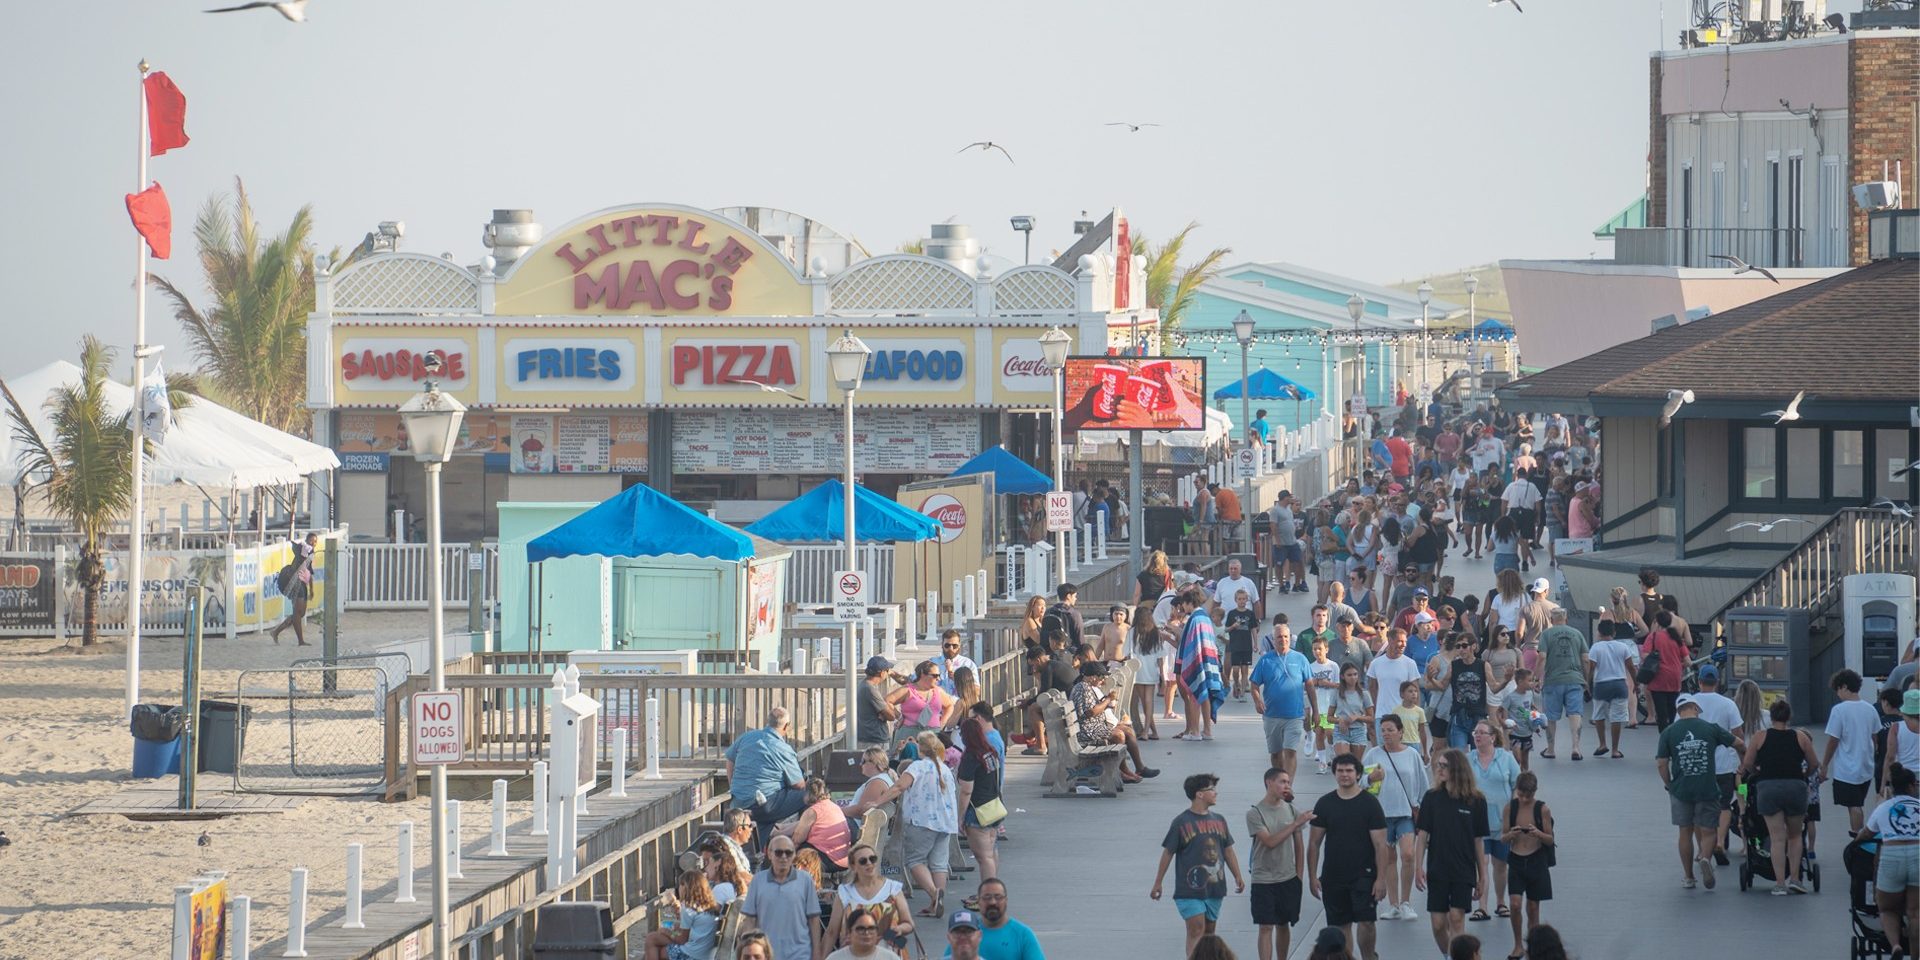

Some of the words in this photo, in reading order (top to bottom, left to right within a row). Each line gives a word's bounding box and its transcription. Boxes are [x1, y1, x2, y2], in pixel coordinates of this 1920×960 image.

[555, 214, 754, 274] LITTLE
[518, 348, 621, 382] FRIES
[673, 345, 797, 385] PIZZA
[862, 350, 963, 381] EAFOOD
[345, 455, 380, 463] FROZEN
[342, 463, 382, 471] LEMONADE
[612, 464, 648, 472] LEMONAD
[1052, 497, 1067, 507] NO
[1864, 581, 1897, 592] ATM
[423, 702, 451, 721] NO
[421, 726, 454, 738] DOGS
[418, 743, 458, 754] ALLOWED
[1180, 823, 1196, 842] LIL
